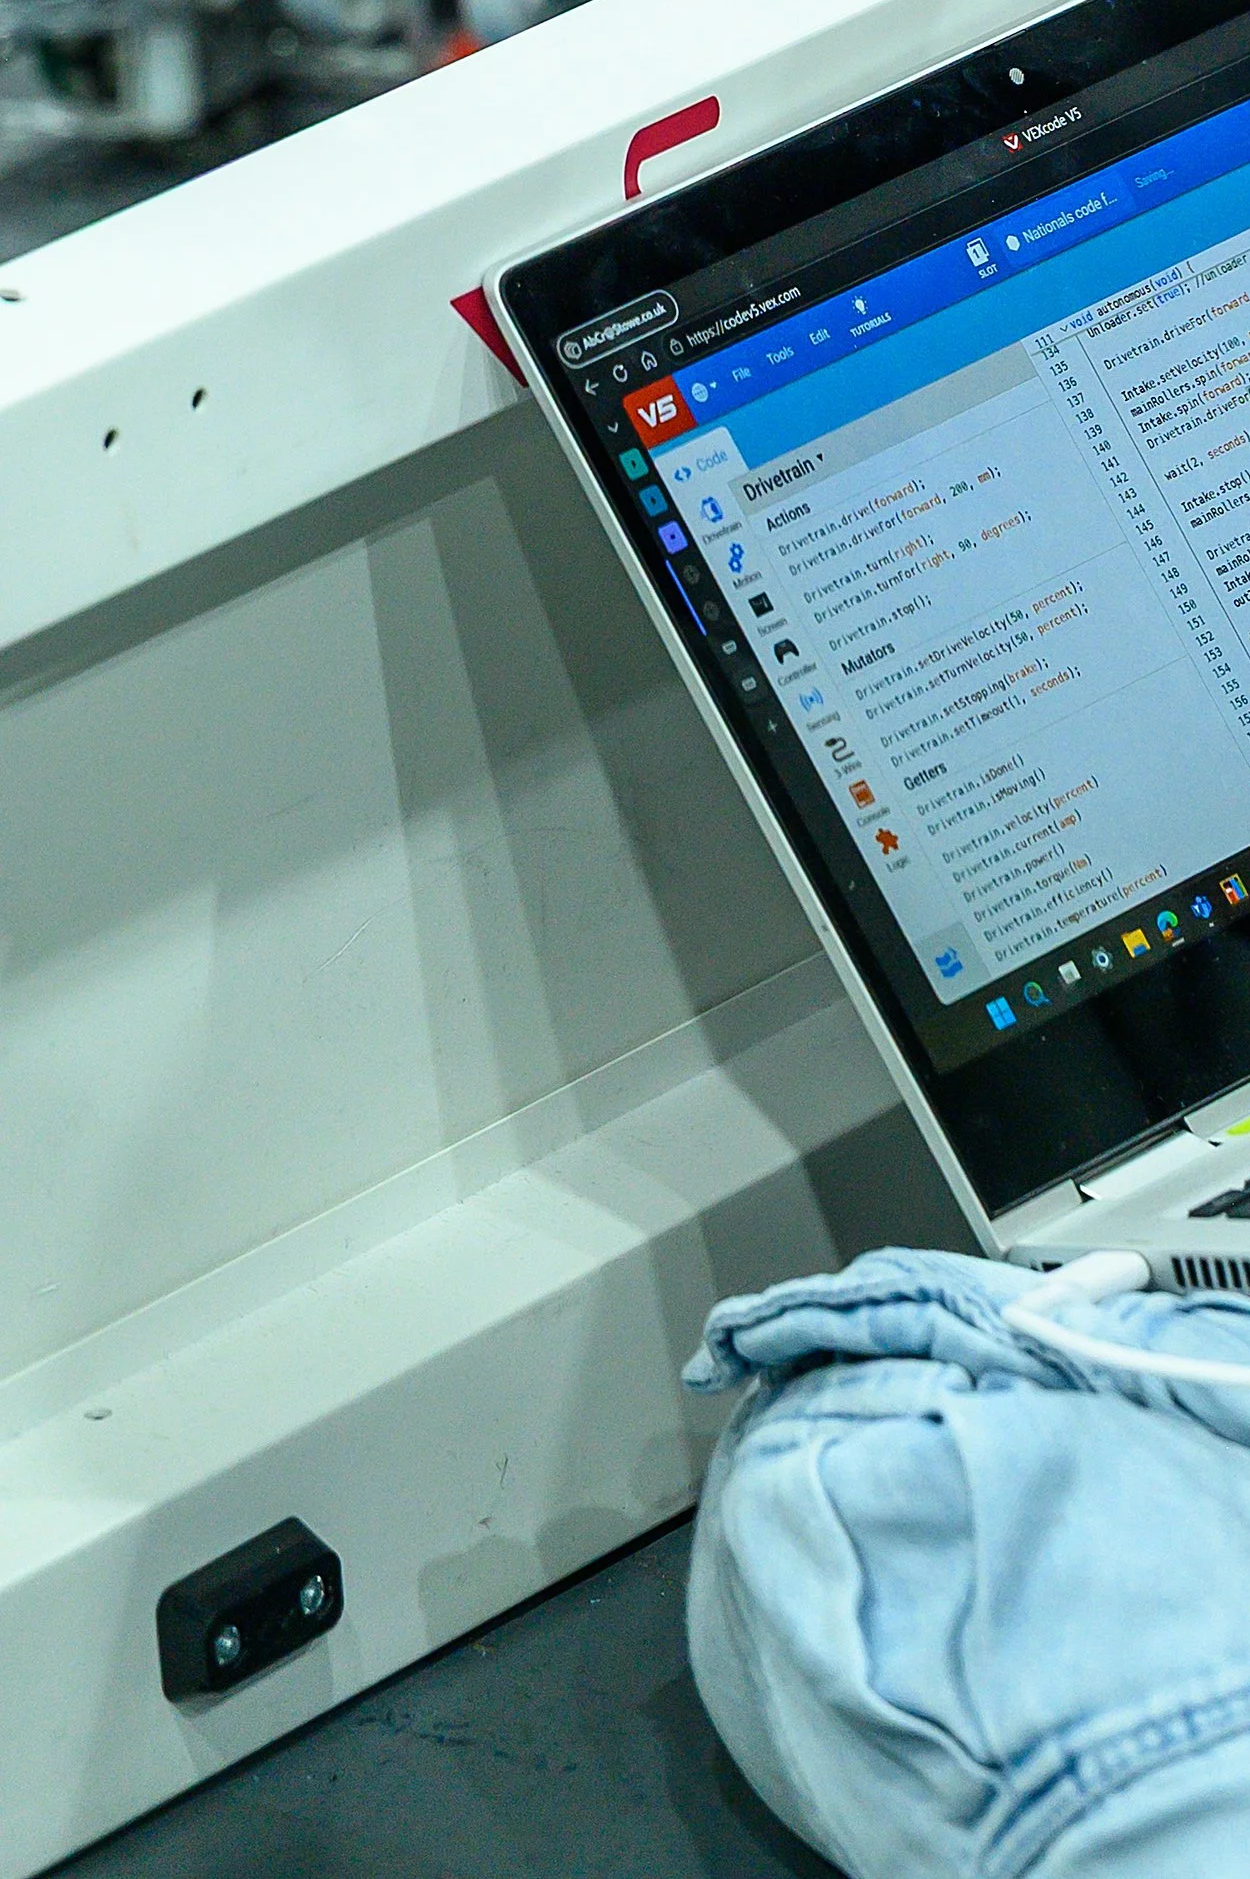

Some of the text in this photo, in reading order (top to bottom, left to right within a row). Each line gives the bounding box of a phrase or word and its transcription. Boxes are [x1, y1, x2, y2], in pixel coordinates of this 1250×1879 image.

[1021, 106, 1081, 141] VEXcode V5
[1022, 211, 1074, 242] Nationals
[1074, 199, 1101, 218] code
[978, 263, 997, 278] SLOT
[687, 287, 800, 345] https://codev5.vex.com
[1034, 333, 1053, 348] 111
[1069, 311, 1093, 328] void
[1097, 268, 1182, 315] autonomous(void)
[1041, 344, 1061, 361] 134
[1086, 282, 1189, 337] Unloader.set(true);
[1193, 255, 1246, 288] //unloader
[849, 312, 891, 336] TUTORIALS
[809, 328, 830, 344] Edit
[765, 346, 794, 364] Tools
[731, 367, 751, 381] File
[1049, 360, 1068, 376] 135
[1058, 376, 1077, 391] 136
[1075, 408, 1094, 423] 138
[1121, 337, 1244, 400] Intake.setVelocity(100,
[1066, 392, 1084, 407] 137
[638, 394, 676, 426] V5
[1092, 440, 1111, 455] 140
[1138, 373, 1250, 432] Intake.spin(forward);
[1083, 424, 1102, 439] 139
[695, 450, 727, 471] Code
[1100, 456, 1119, 471] 141
[743, 459, 814, 500] Drivetrain
[1109, 471, 1128, 487] 142
[1118, 487, 1137, 503] 143
[1164, 457, 1203, 480] wait(2,
[766, 503, 810, 531] Actions
[1126, 503, 1145, 519] 144
[1135, 519, 1153, 534] 145
[1144, 535, 1162, 551] 146
[1152, 551, 1169, 566] 147
[1161, 567, 1179, 582] 148
[1169, 583, 1188, 598] 149
[1177, 599, 1196, 614] 150
[1186, 615, 1205, 630] 151
[1195, 630, 1214, 646] 152
[841, 643, 894, 674] Mutators
[1203, 646, 1222, 662] 153
[1212, 662, 1231, 678] 154
[1221, 678, 1239, 694] 155
[1229, 694, 1248, 710] 156
[903, 763, 946, 790] Getters
